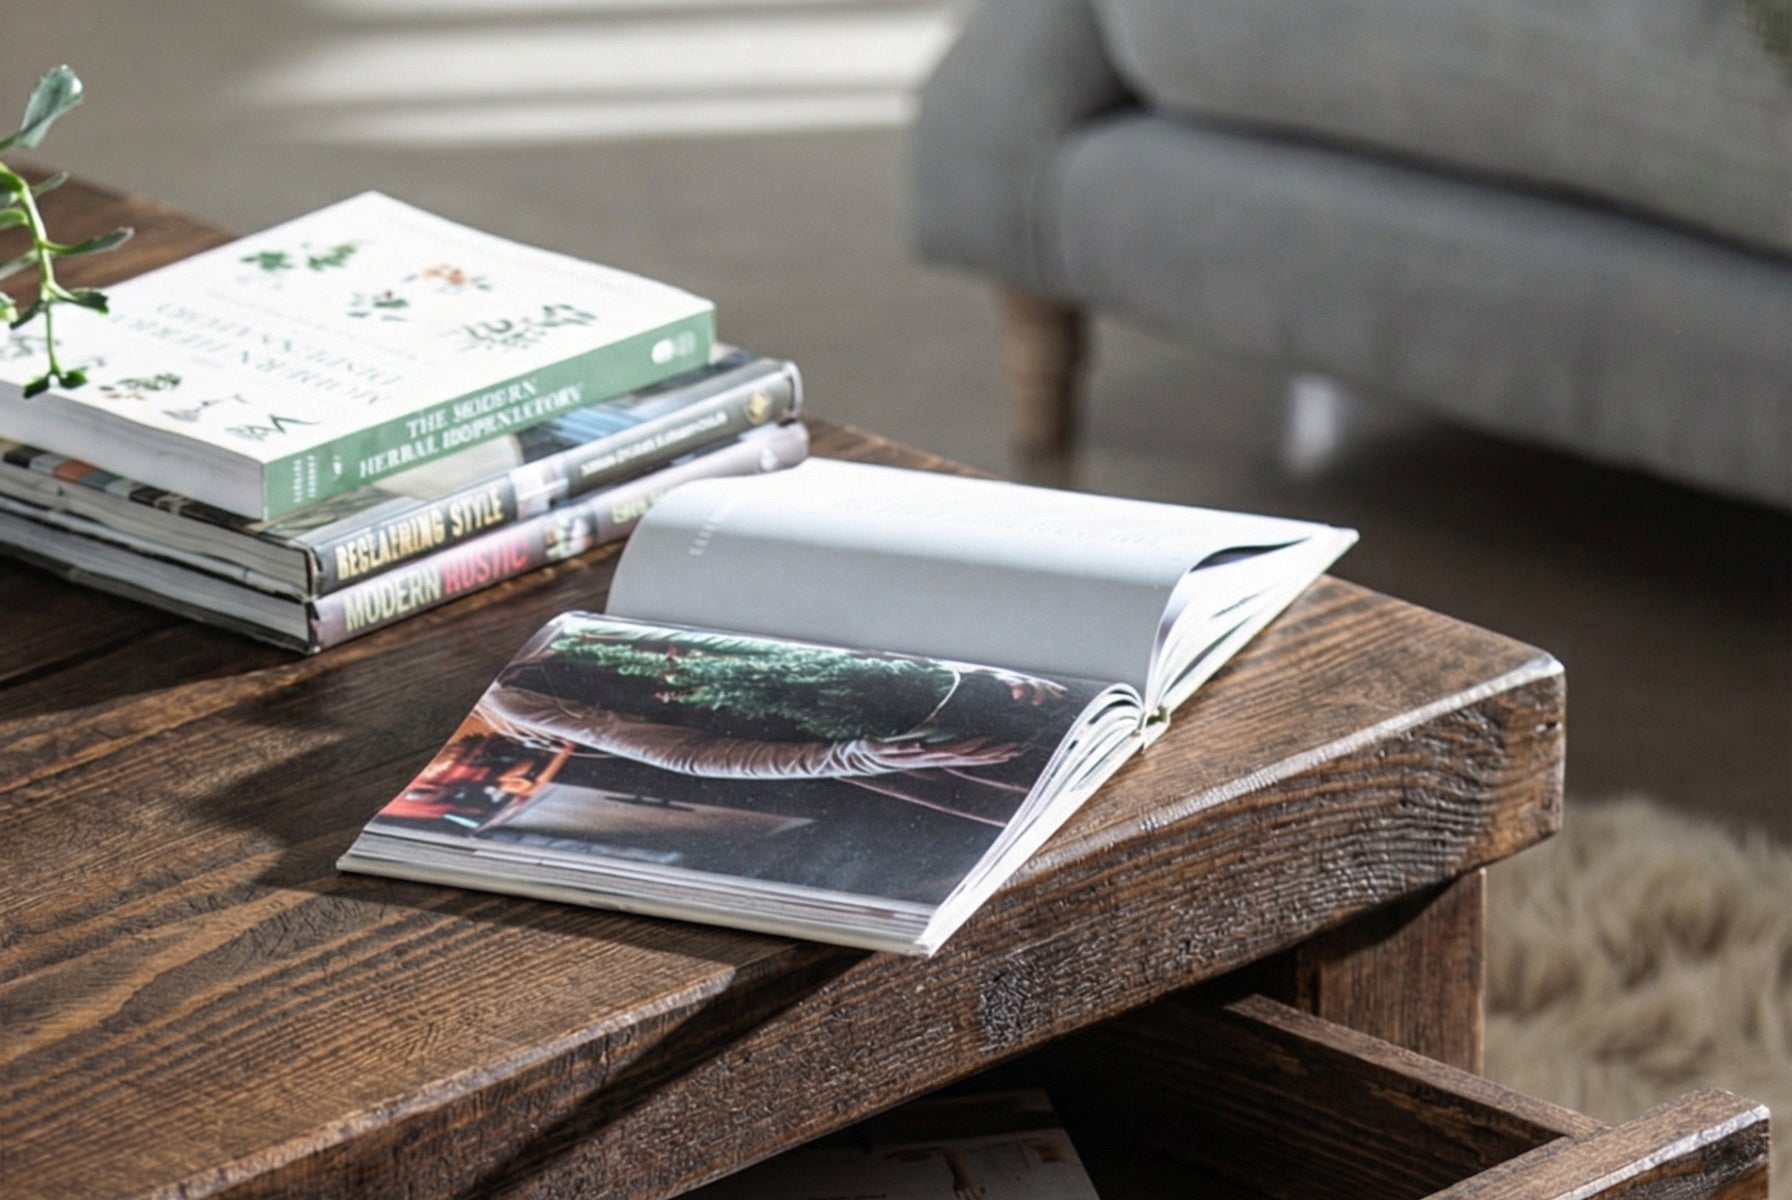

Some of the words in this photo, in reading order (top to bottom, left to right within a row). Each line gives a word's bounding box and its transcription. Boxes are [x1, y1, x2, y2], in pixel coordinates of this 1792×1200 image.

[405, 409, 449, 439] THE
[452, 488, 505, 537] STYLE
[344, 565, 441, 633] MODERN
[442, 538, 530, 596] RUSTIC
